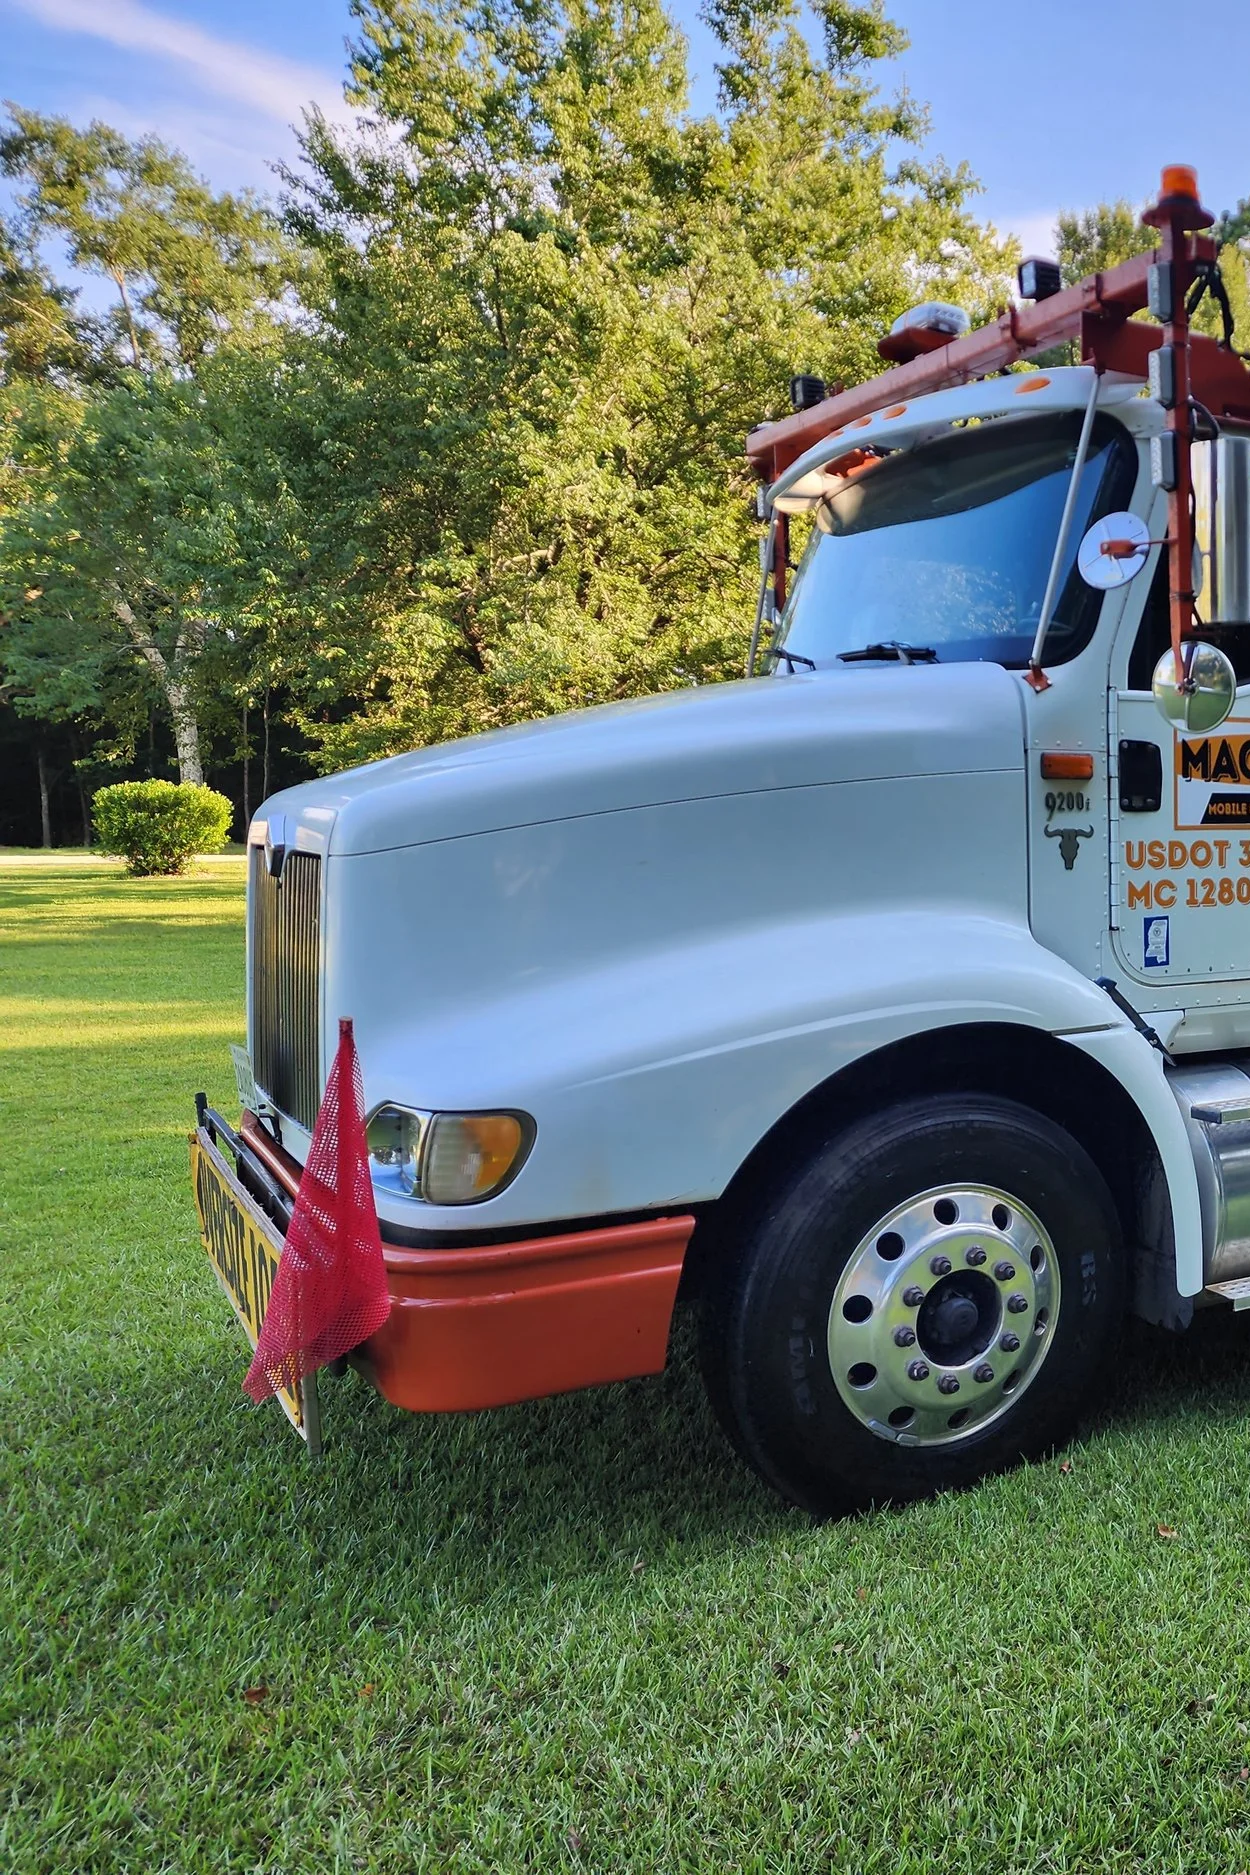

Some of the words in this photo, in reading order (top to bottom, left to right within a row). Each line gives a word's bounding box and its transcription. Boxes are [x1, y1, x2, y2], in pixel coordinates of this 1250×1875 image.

[1045, 791, 1090, 822] 9200i
[1208, 803, 1248, 815] MOBILE
[1125, 840, 1231, 870] USDOT
[1127, 879, 1178, 910] MC
